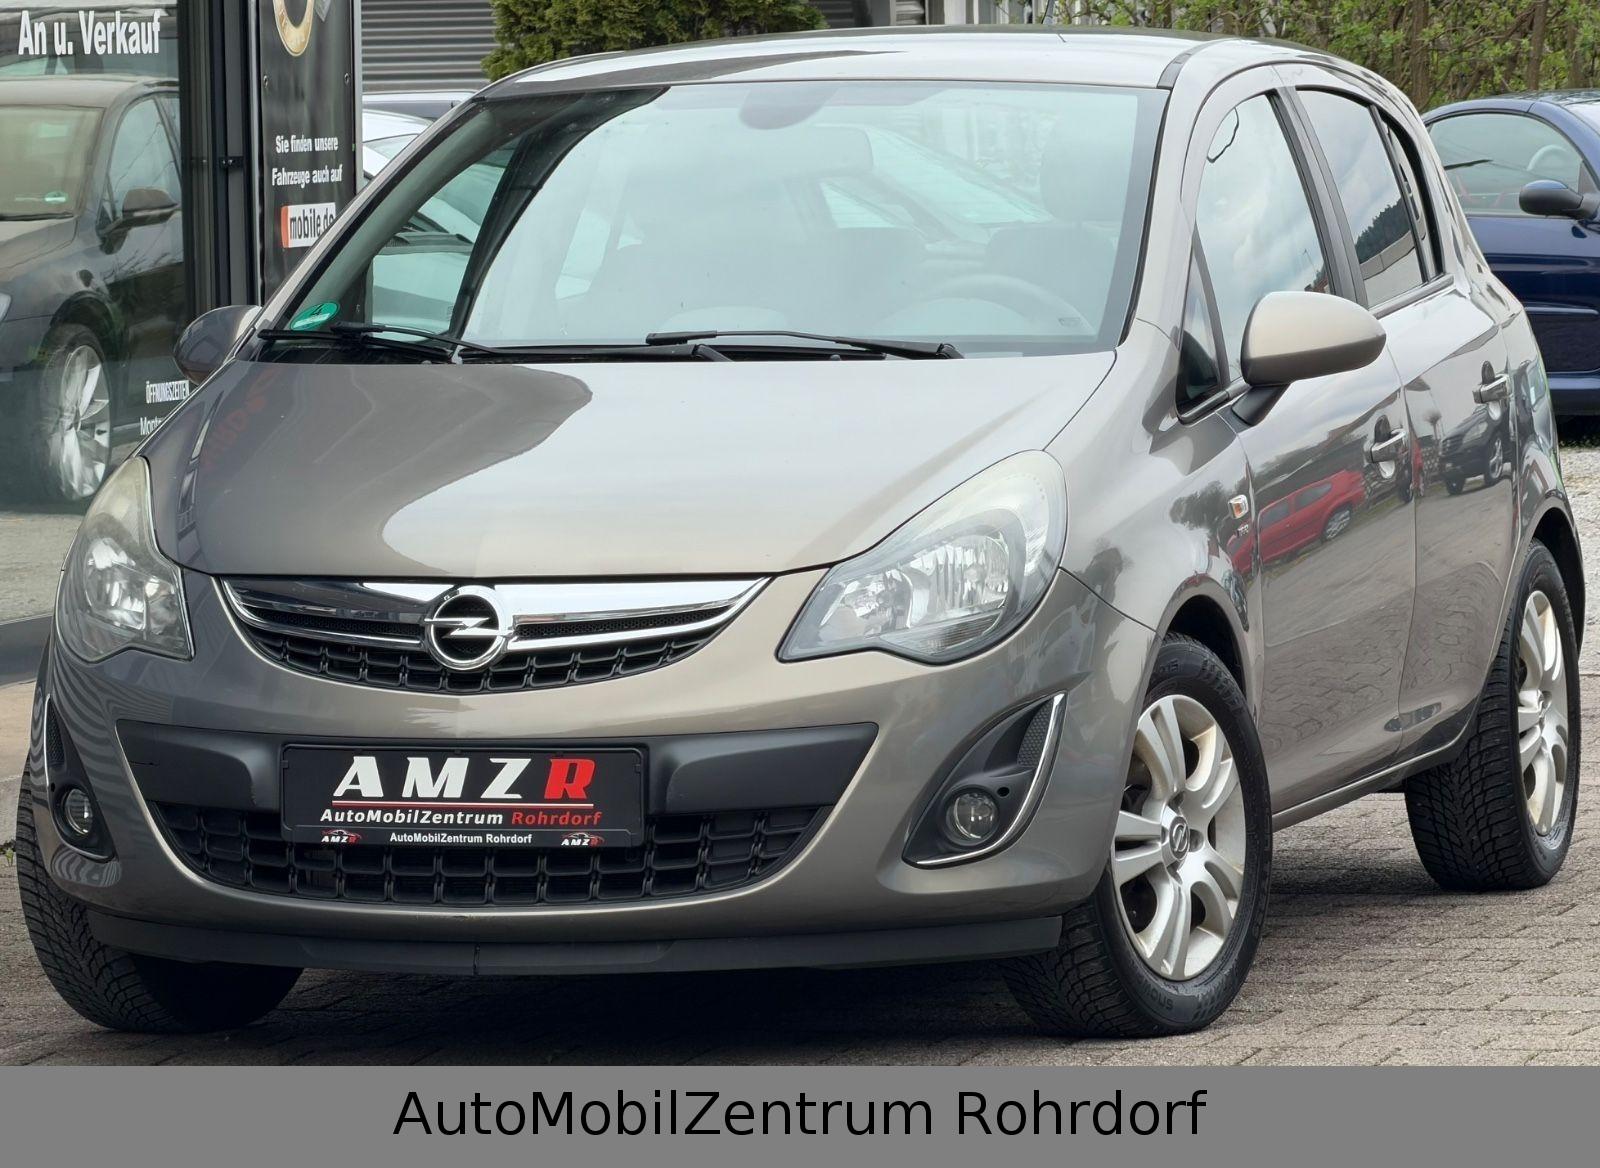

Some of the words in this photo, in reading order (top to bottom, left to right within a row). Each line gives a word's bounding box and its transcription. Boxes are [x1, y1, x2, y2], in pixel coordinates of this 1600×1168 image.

[18, 10, 47, 55] An
[53, 22, 73, 55] u.
[78, 10, 160, 55] Verkauf
[276, 135, 289, 153] Sie
[291, 134, 313, 152] finden
[314, 137, 338, 151] unsere
[271, 167, 310, 188] Fahrzeuge
[312, 165, 329, 183] auch
[330, 164, 343, 182] auf
[290, 208, 335, 240] mobiled
[320, 808, 503, 825] AutoMobilZentrum
[511, 811, 602, 826] Rohrdorf
[389, 832, 483, 844] AutoMobilZentrum
[486, 833, 533, 844] Rohrdorf
